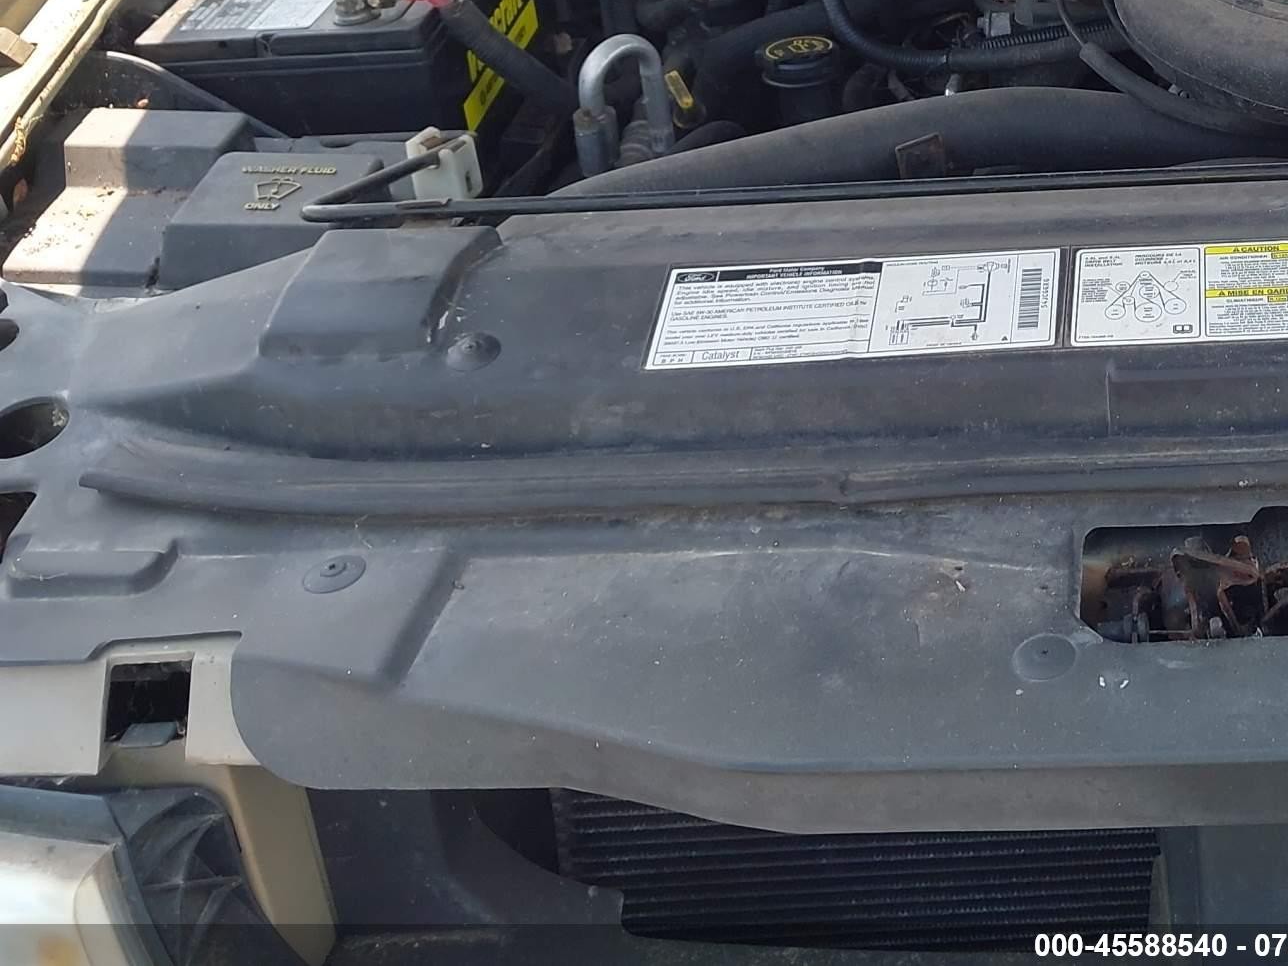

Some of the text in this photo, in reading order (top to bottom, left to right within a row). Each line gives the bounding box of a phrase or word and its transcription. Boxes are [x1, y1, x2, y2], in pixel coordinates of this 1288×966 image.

[300, 165, 337, 175] FLUID
[244, 202, 280, 211] ONLY
[1227, 288, 1251, 296] MISE
[1253, 287, 1267, 295] EN
[701, 350, 740, 362] Catalyst
